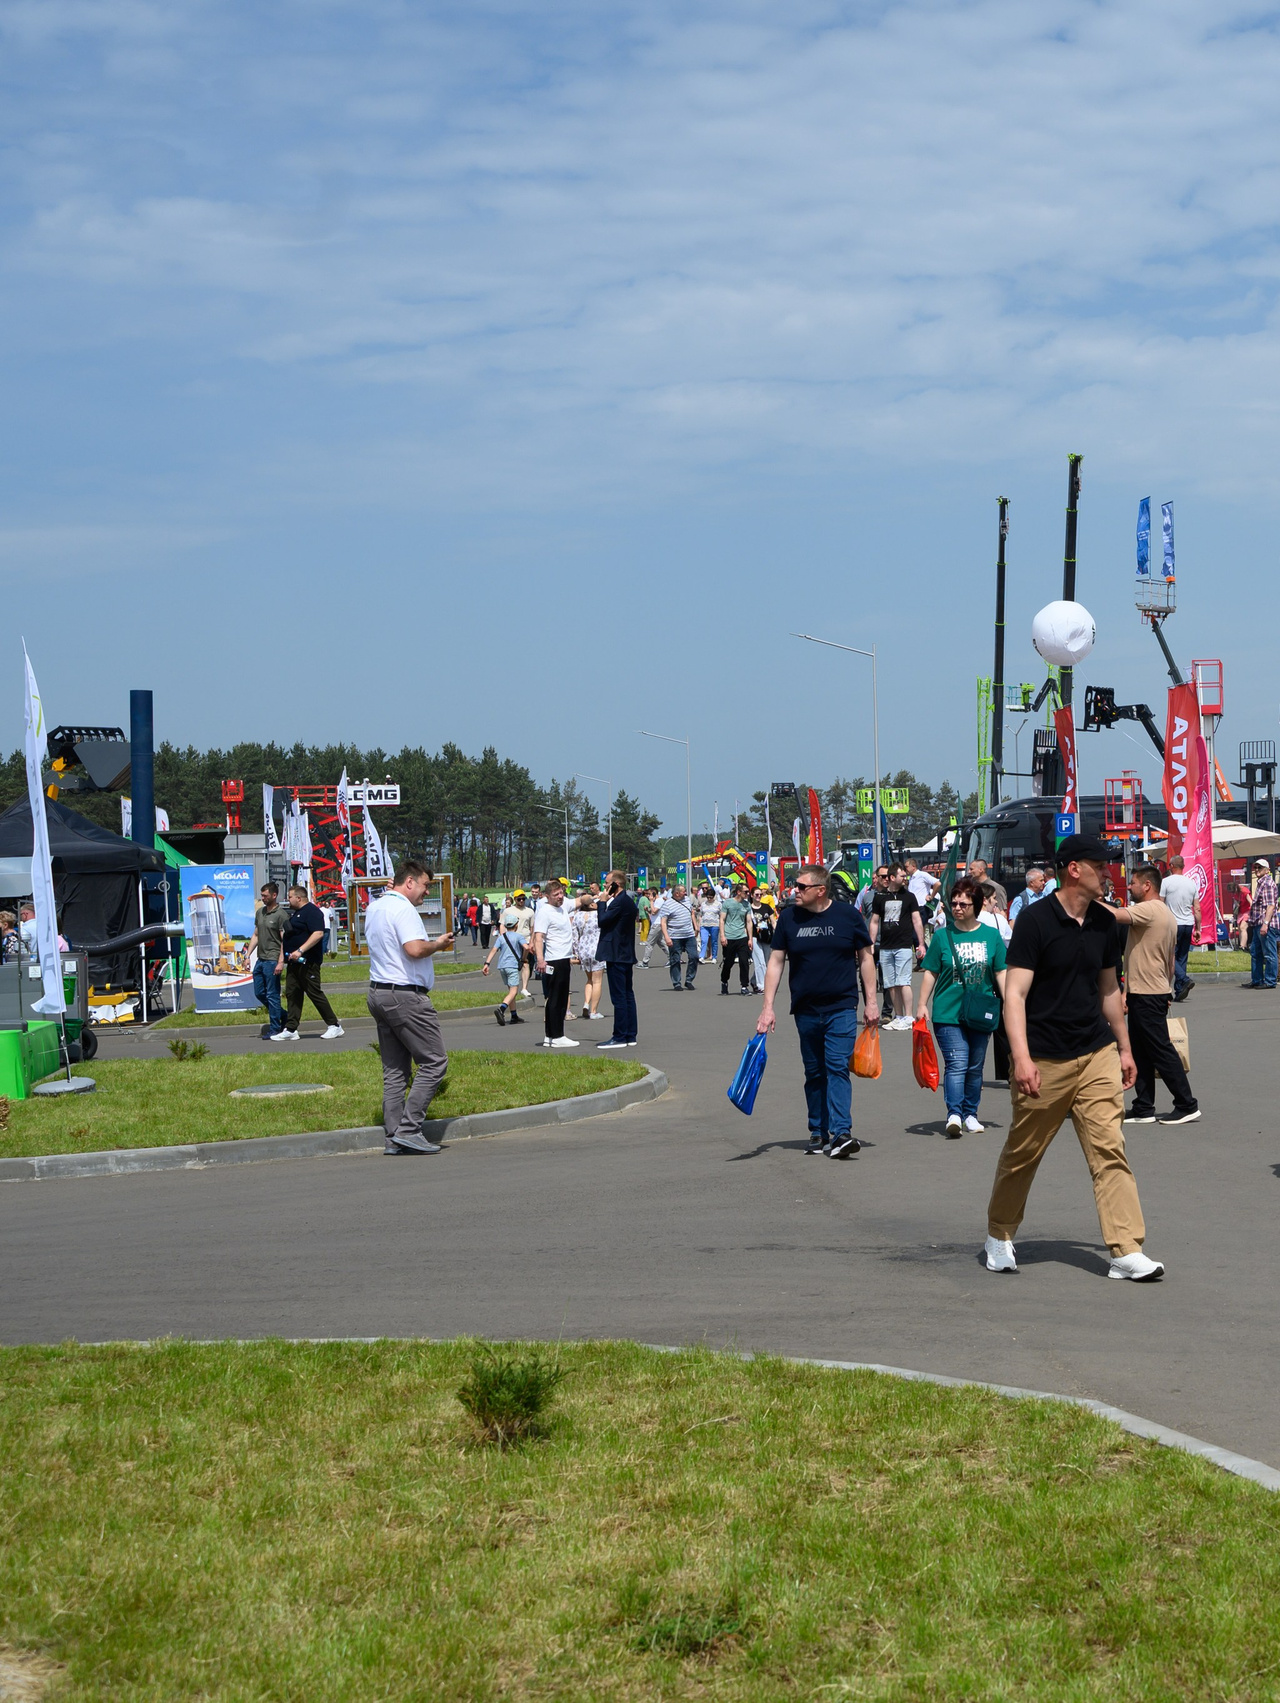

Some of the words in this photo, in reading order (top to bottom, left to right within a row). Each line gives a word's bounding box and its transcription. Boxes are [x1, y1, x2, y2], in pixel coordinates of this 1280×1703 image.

[1062, 820, 1070, 831] P
[863, 849, 869, 857] P
[758, 871, 766, 879] N
[862, 868, 871, 878] N
